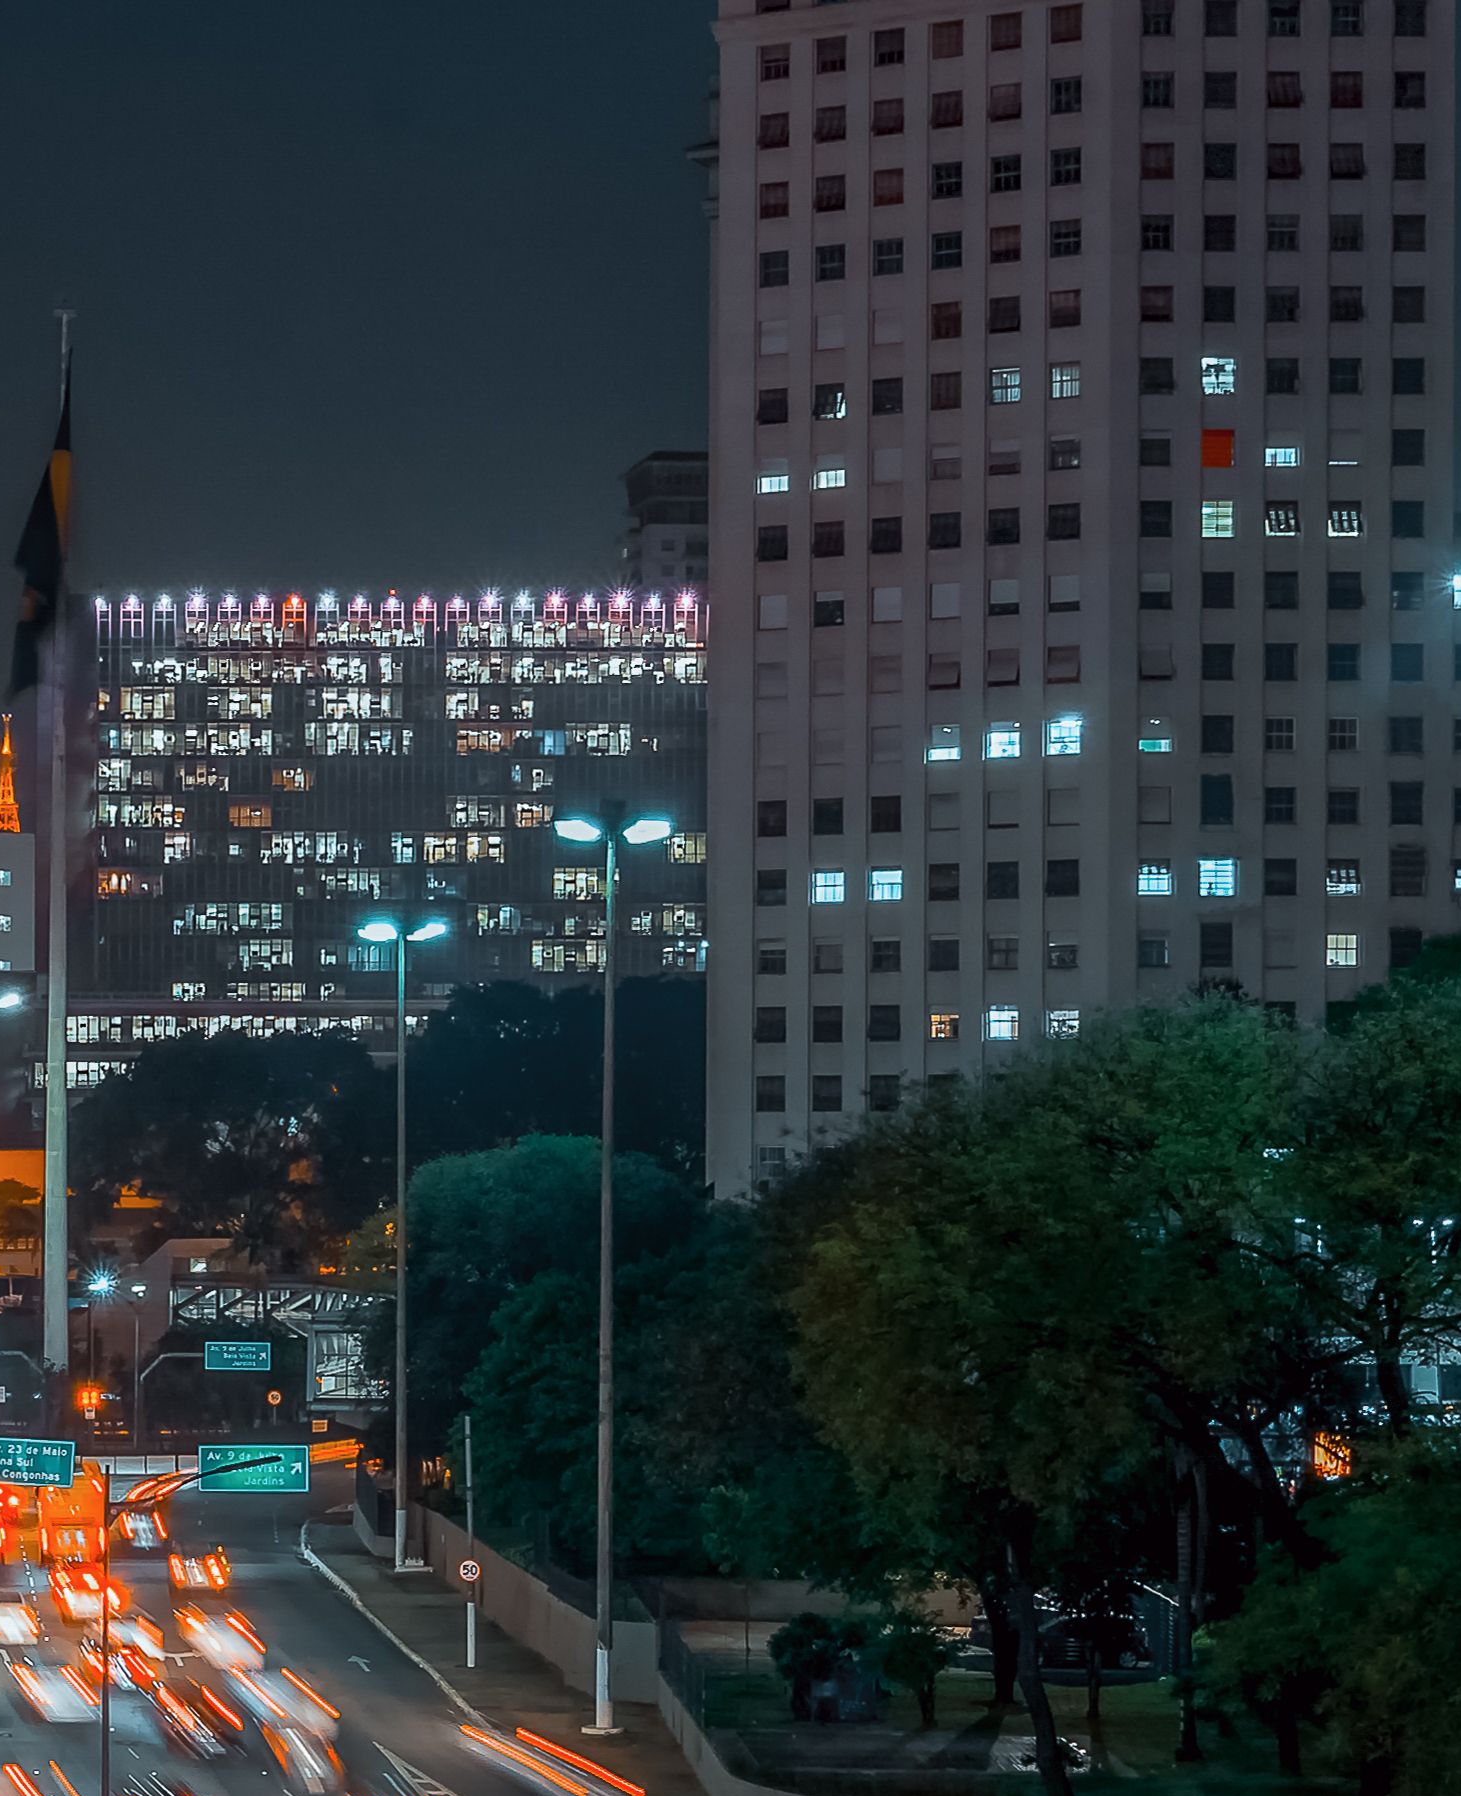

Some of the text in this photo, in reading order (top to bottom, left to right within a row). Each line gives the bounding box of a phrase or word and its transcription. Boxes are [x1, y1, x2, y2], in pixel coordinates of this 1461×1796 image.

[8, 1444, 22, 1454] 23
[26, 1445, 38, 1455] de
[42, 1446, 68, 1457] Maio
[207, 1451, 223, 1461] Av.
[227, 1451, 235, 1460] 9
[239, 1451, 251, 1461] de
[16, 1457, 34, 1467] Sul
[2, 1468, 60, 1482] Congonhas
[244, 1475, 285, 1486] Jardins
[462, 1564, 478, 1576] 50
